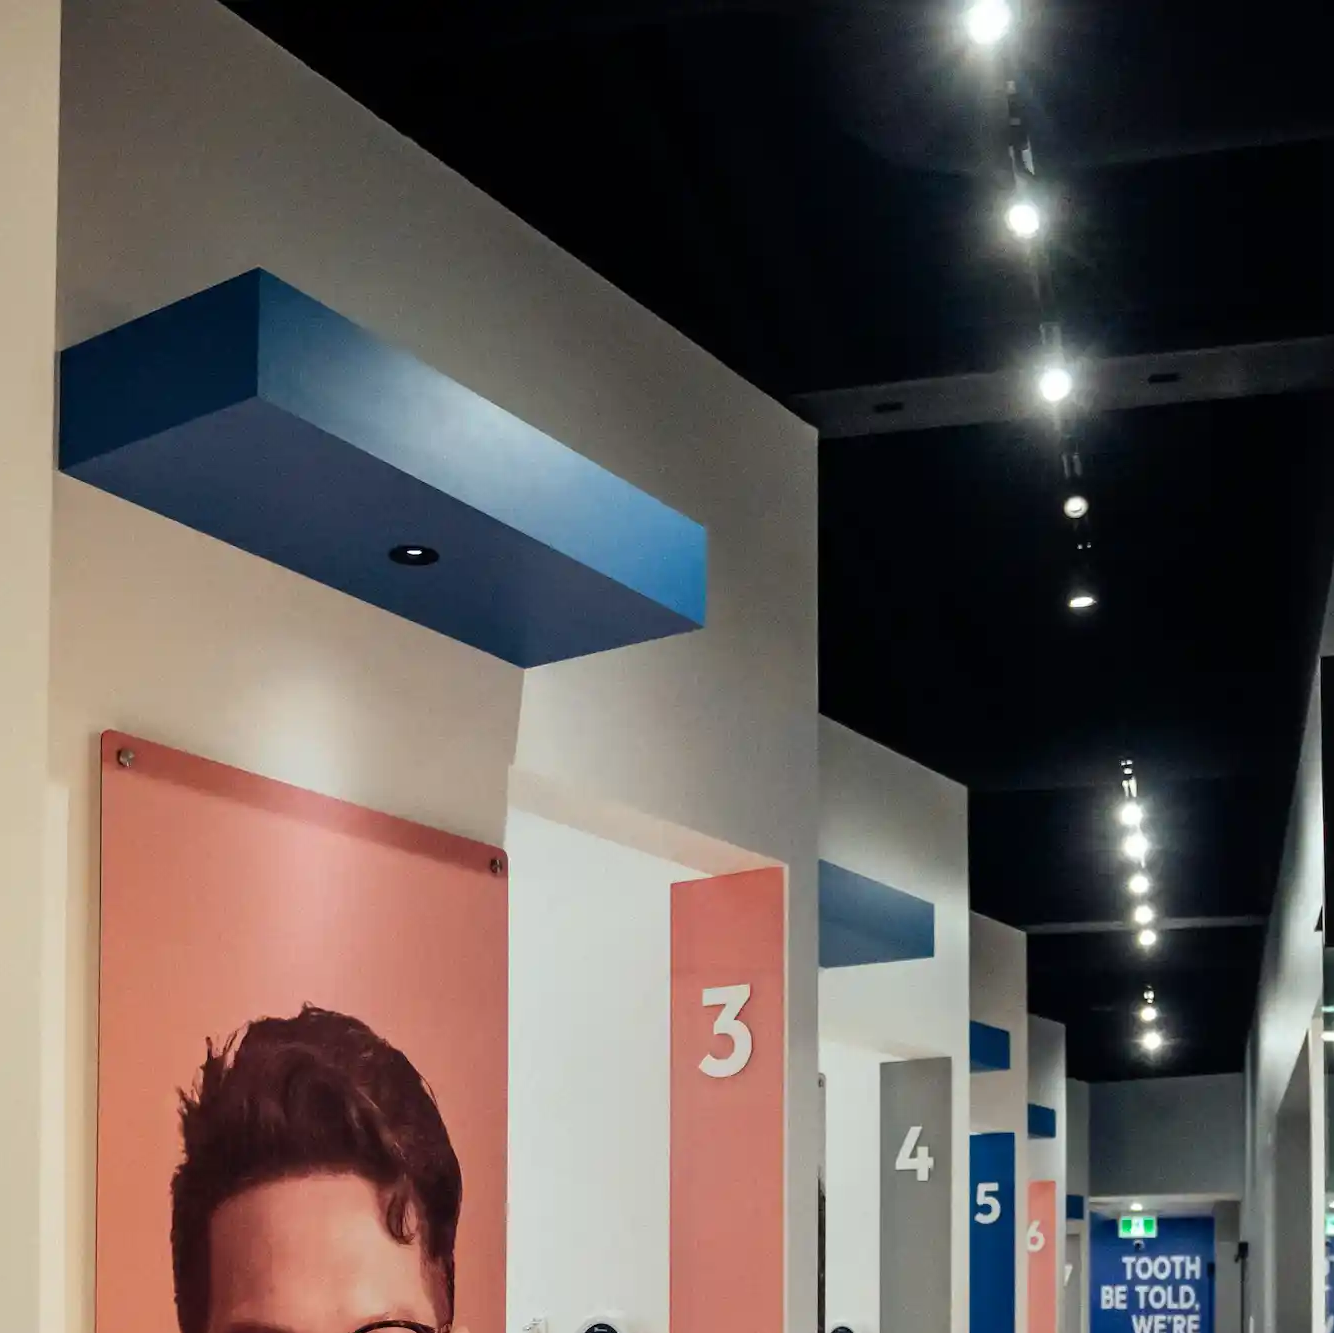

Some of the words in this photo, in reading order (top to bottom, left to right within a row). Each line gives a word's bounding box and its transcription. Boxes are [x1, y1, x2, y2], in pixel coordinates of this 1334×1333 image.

[698, 984, 752, 1077] 3
[895, 1126, 934, 1181] 4
[974, 1182, 1001, 1224] 5
[1026, 1220, 1045, 1253] 6
[1122, 1255, 1201, 1280] TOOTH
[1100, 1285, 1127, 1310] BE
